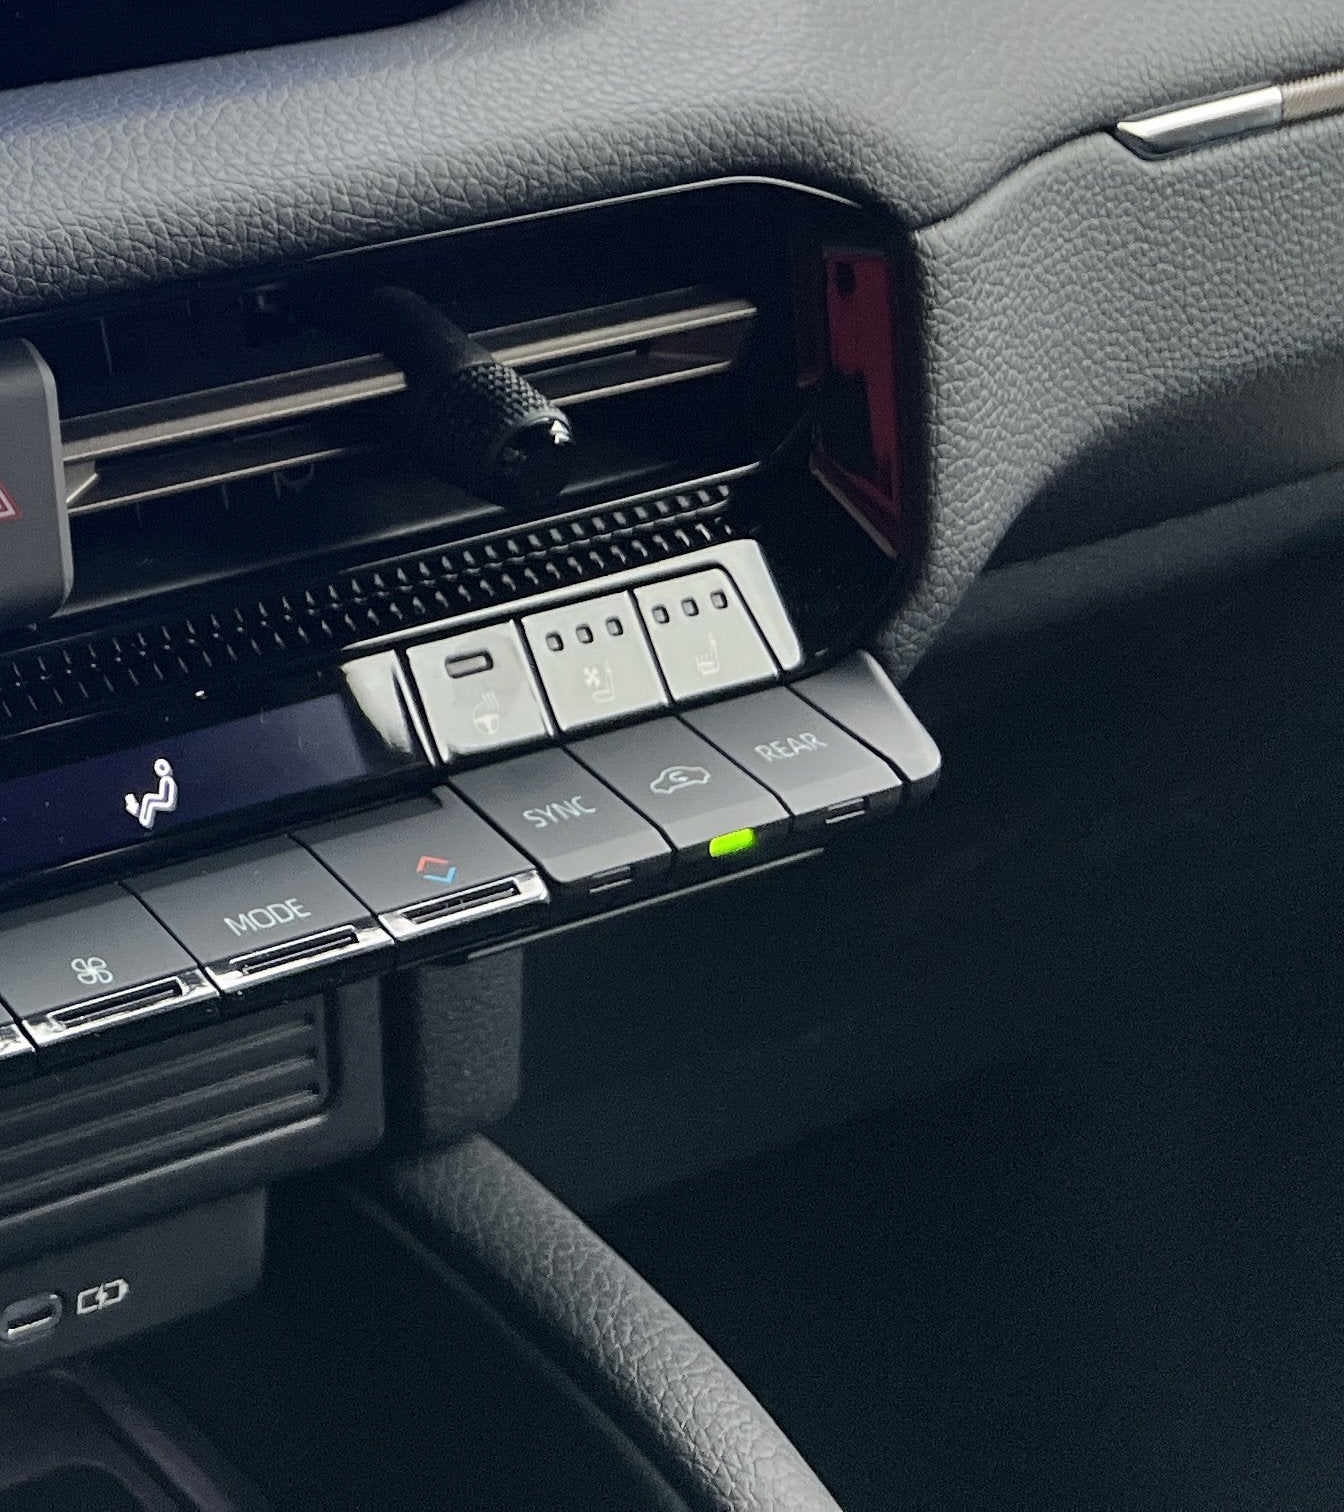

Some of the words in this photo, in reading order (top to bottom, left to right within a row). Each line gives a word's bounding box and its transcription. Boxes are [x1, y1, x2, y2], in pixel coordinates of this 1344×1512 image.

[754, 729, 829, 764] REAR
[522, 793, 597, 831] SYNC
[223, 896, 313, 937] MODE
